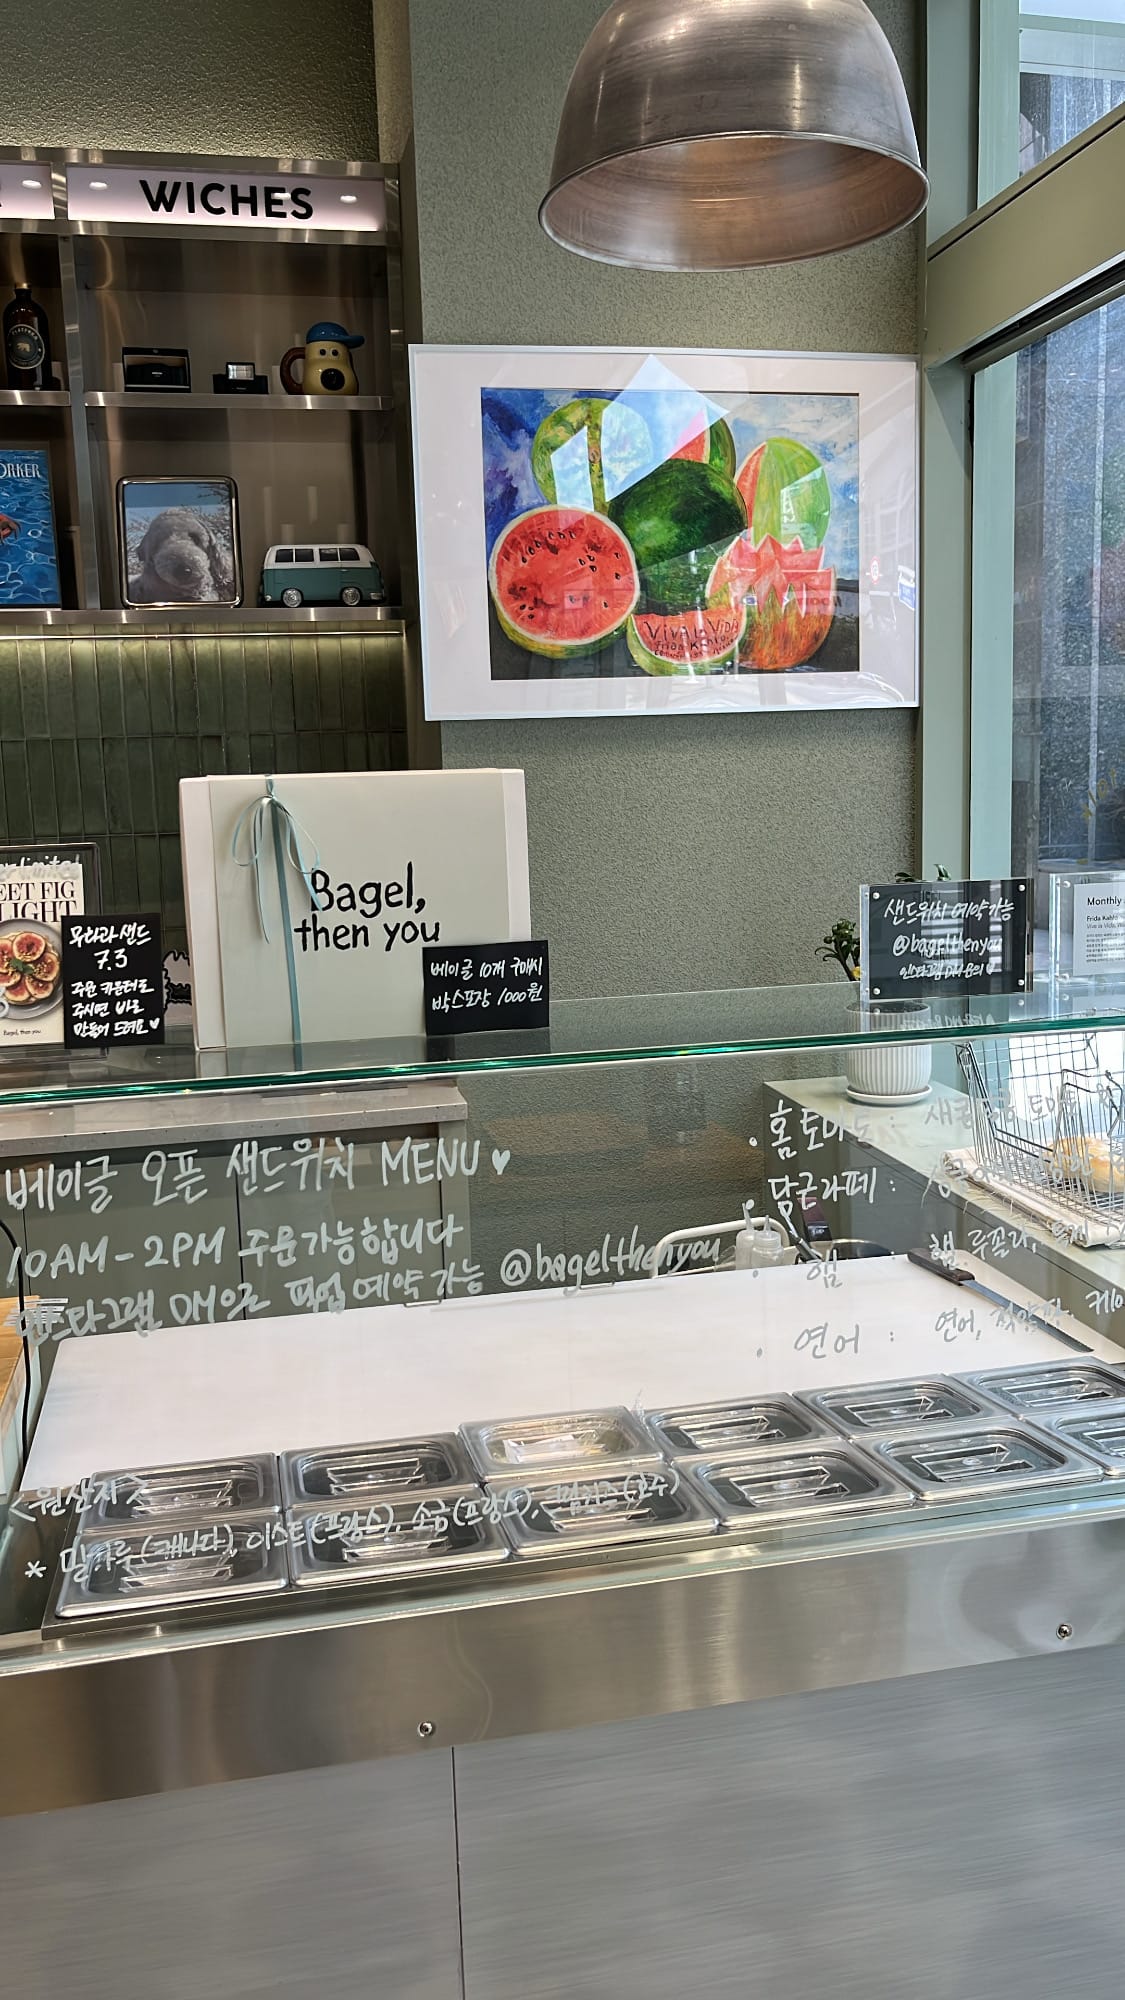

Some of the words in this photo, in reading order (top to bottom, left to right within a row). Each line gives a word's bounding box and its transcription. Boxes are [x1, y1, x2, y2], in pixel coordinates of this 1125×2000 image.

[139, 179, 313, 220] WICHES
[41, 881, 75, 899] FIG
[311, 861, 426, 918] Bagel,
[1087, 896, 1122, 906] Monthly
[884, 898, 947, 926] 샌드위치
[294, 914, 370, 951] then
[383, 921, 440, 951] you
[892, 931, 1003, 958] @bagelthenyou
[93, 948, 129, 971] 7.3
[430, 958, 473, 980] 베이글
[479, 960, 505, 979] 10개
[510, 957, 543, 977] 구매시
[71, 981, 98, 998] 주문
[431, 989, 491, 1014] 박스포장
[497, 982, 543, 1006] 1000원
[72, 1002, 110, 1018] 주시면
[115, 999, 145, 1014] 바로
[5, 1155, 118, 1214] 베이글
[142, 1149, 208, 1205] 오픈
[226, 1137, 355, 1195] 샌드위치
[381, 1136, 481, 1185] MENU
[500, 1225, 720, 1296] @bagelthenyou
[794, 1322, 860, 1359] 연어
